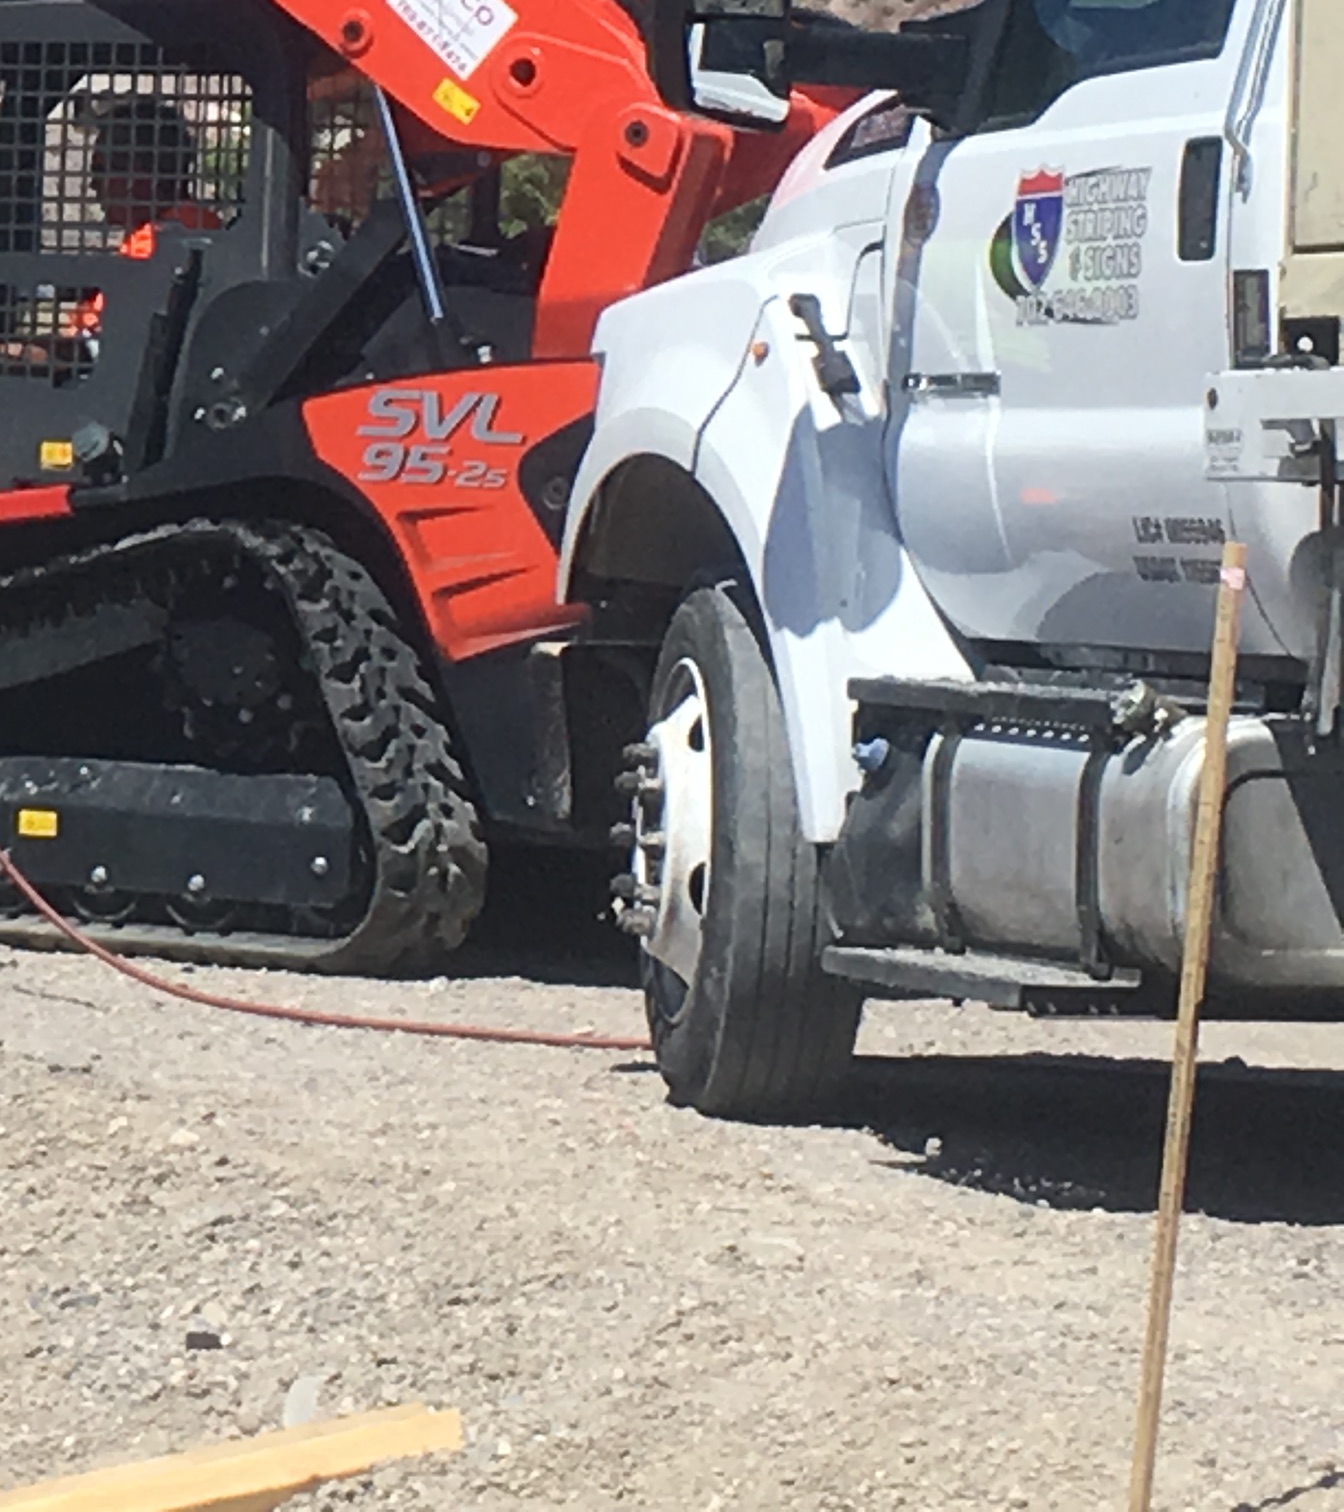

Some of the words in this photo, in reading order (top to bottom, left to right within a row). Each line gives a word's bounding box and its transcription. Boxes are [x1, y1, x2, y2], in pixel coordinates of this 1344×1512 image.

[1064, 167, 1152, 207] HIGHWAY
[1066, 204, 1148, 243] STRIPING
[1083, 242, 1141, 281] SIGNS
[356, 389, 525, 444] SVL
